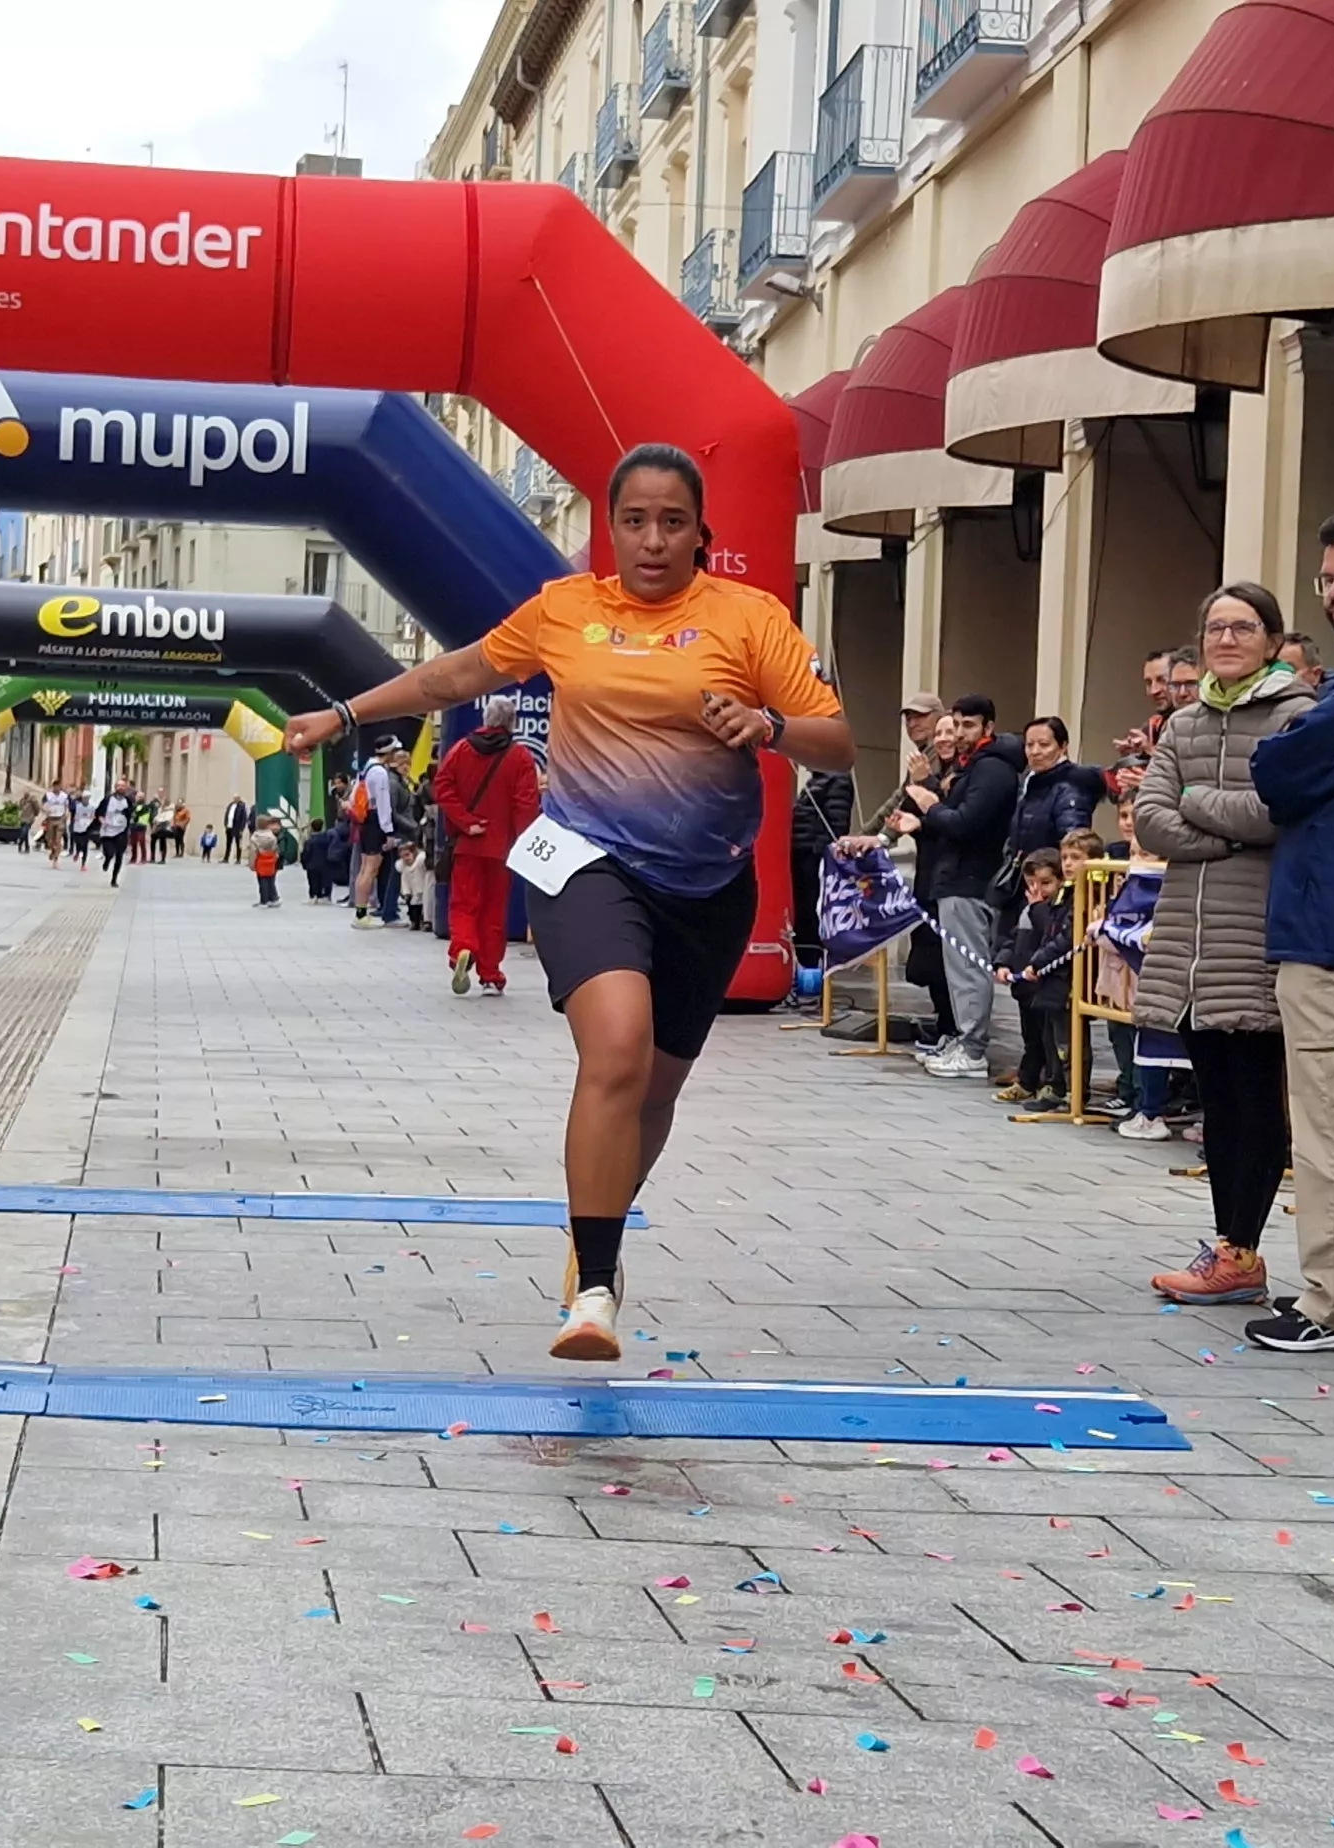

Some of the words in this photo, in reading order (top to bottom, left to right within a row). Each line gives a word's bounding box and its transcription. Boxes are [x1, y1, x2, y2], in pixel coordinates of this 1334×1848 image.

[58, 401, 310, 488] mupol
[37, 594, 226, 641] embou
[526, 835, 557, 863] 383
